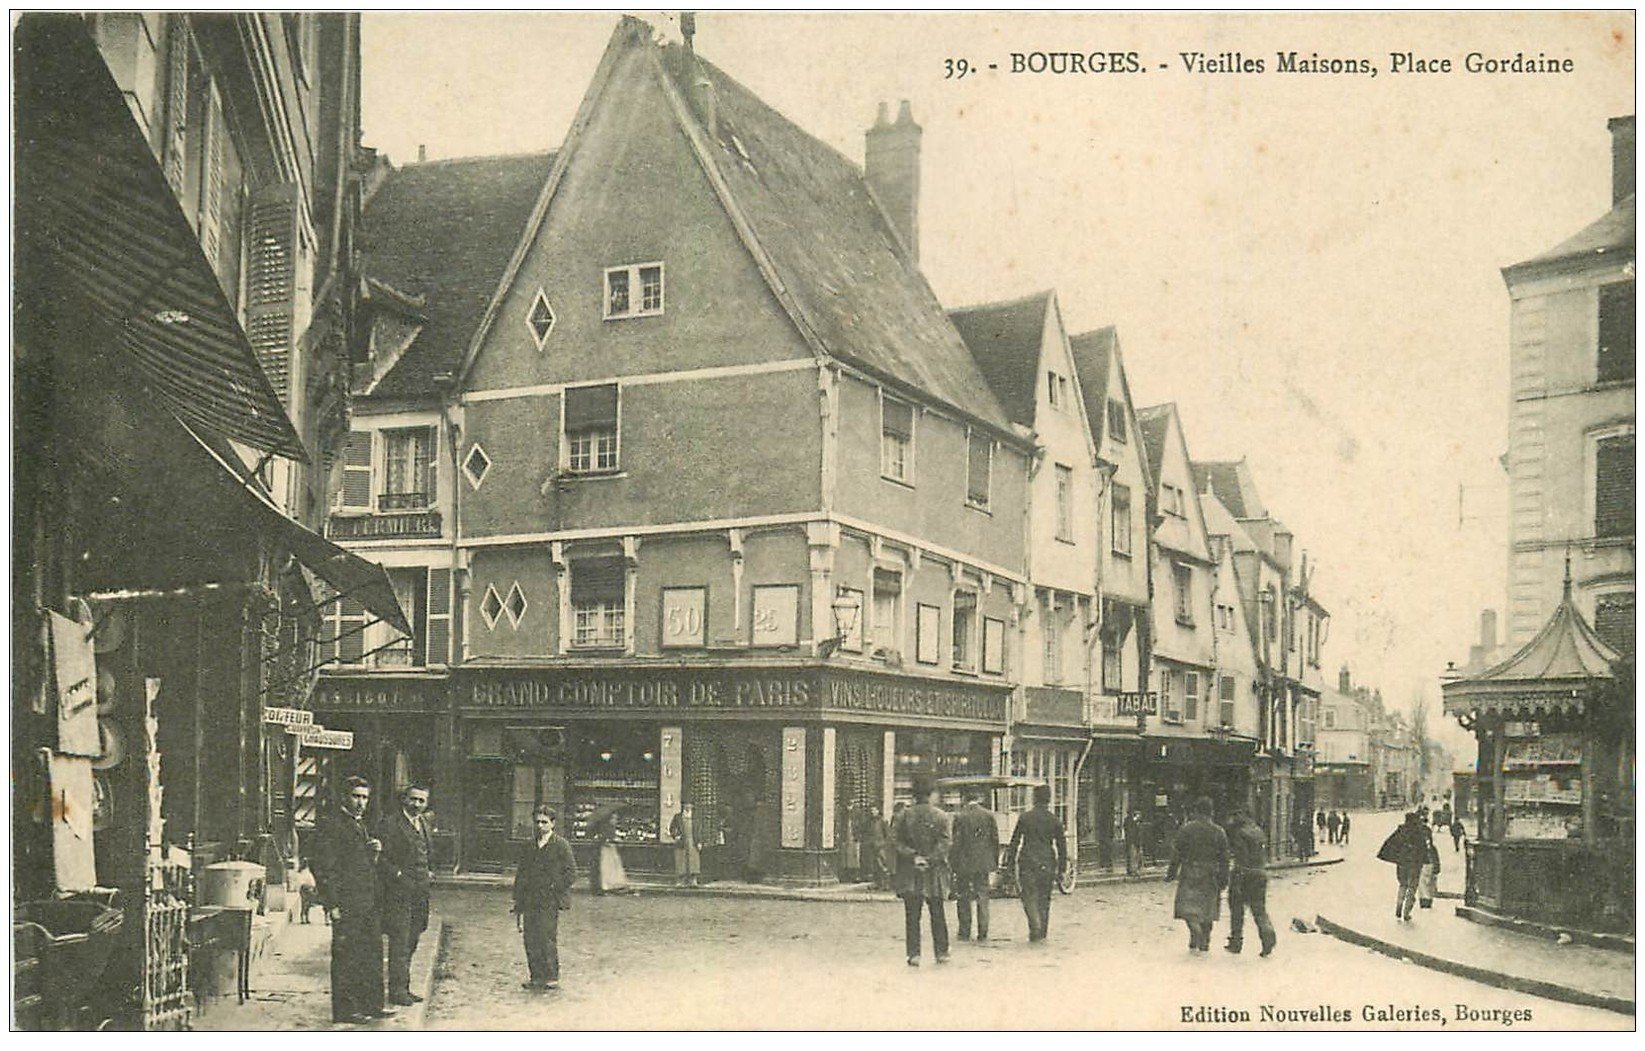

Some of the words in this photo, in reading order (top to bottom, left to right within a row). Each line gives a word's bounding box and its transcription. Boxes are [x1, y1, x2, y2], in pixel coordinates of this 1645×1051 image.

[667, 606, 701, 637] 50
[472, 680, 549, 706] GRAND
[559, 679, 677, 706] COMPTOIR
[691, 680, 723, 706] DE
[737, 679, 809, 706] PARIS
[831, 680, 860, 707] VINS
[1118, 694, 1157, 712] TABAC
